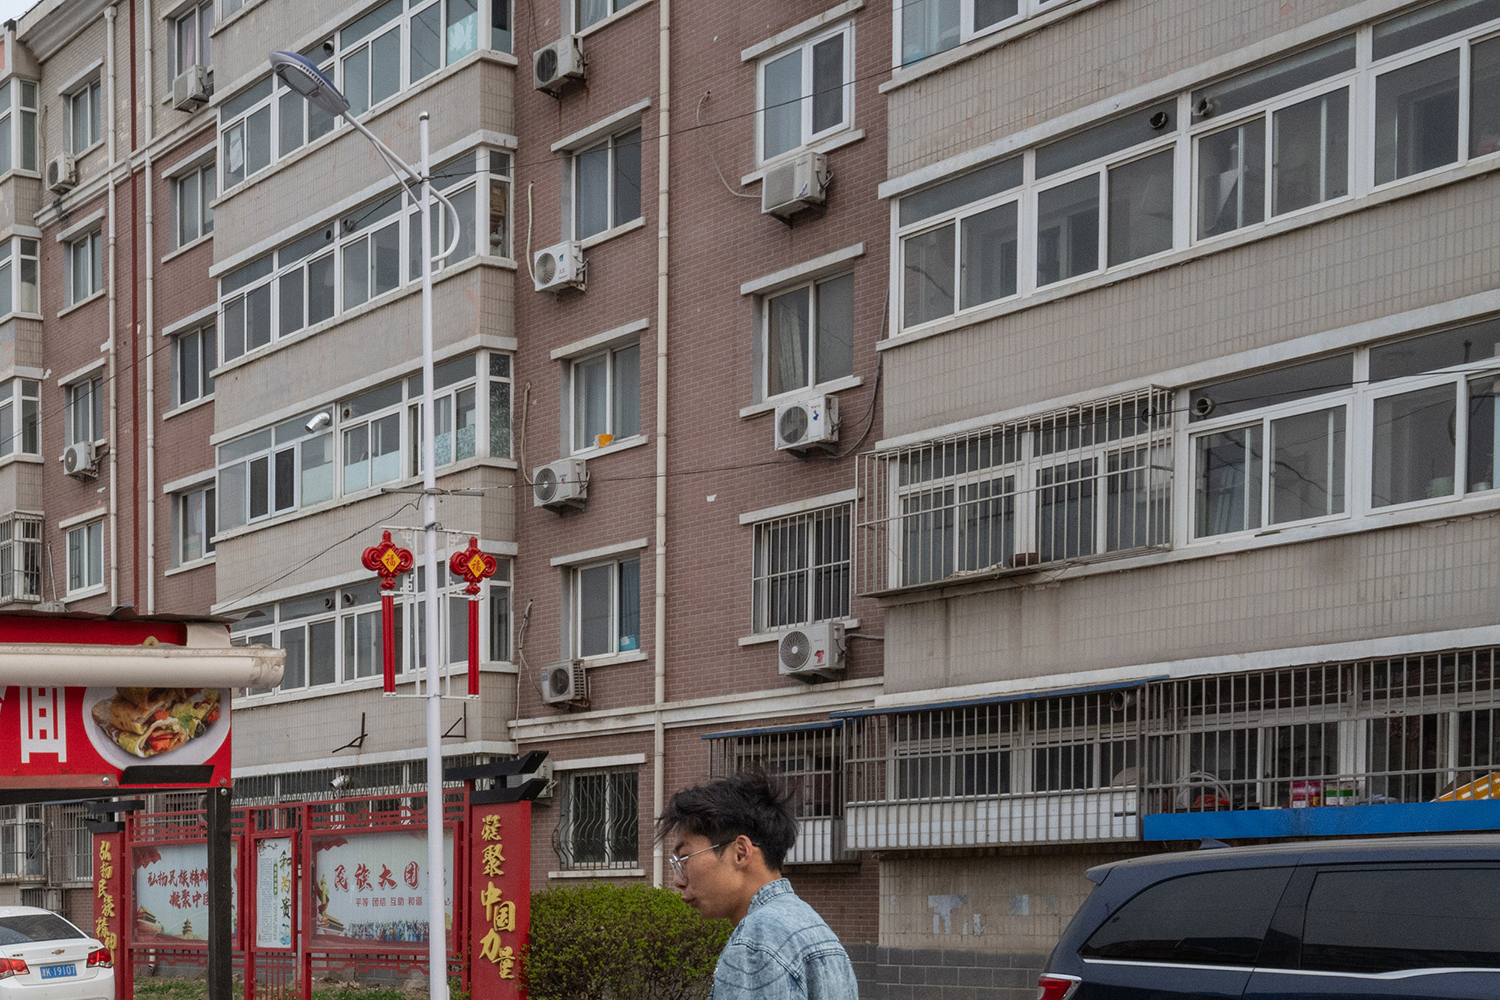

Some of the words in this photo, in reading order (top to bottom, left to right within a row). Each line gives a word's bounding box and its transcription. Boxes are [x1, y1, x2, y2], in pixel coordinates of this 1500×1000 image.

[385, 553, 397, 569] 福
[471, 559, 482, 573] 福
[333, 860, 447, 892] 民族大团
[95, 840, 118, 964] 弘扬民族精神
[355, 897, 369, 908] 平等
[372, 897, 387, 907] 团结
[390, 897, 405, 907] 互助
[408, 896, 423, 906] 和谐
[479, 814, 516, 979] 凝聚中国力量
